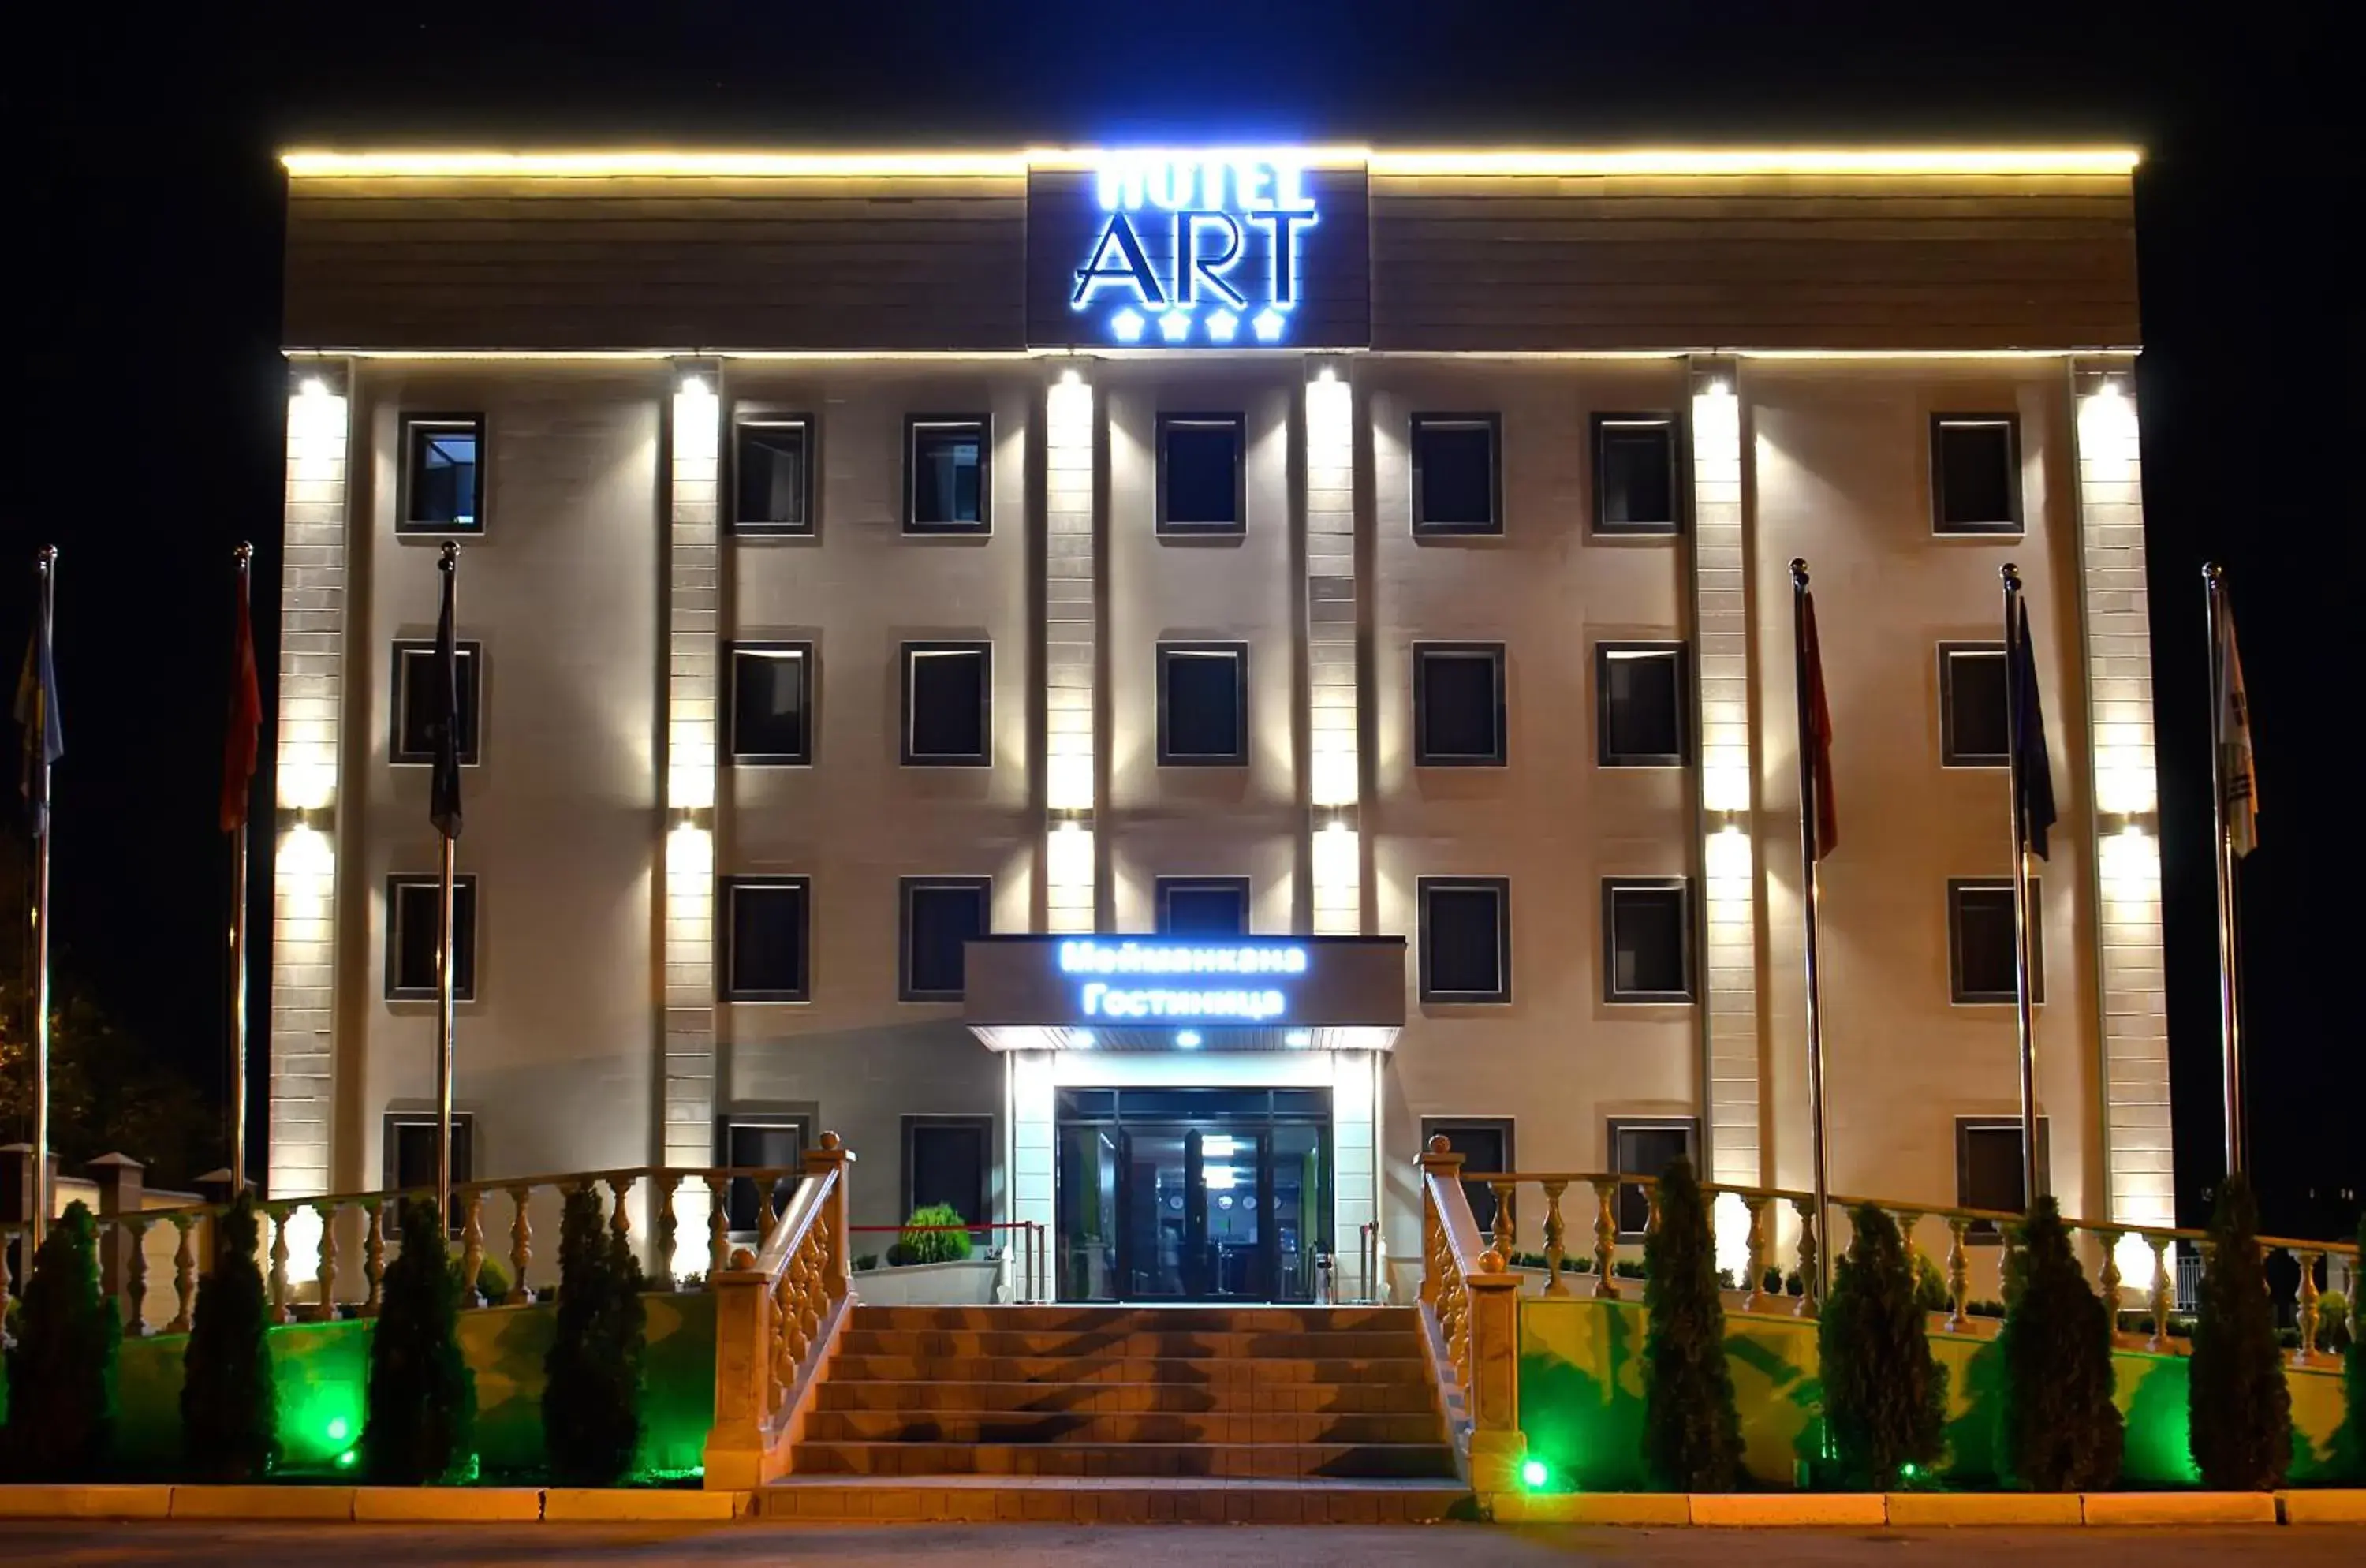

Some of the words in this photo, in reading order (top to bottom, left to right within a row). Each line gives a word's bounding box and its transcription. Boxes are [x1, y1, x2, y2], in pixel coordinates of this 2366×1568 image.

[1098, 150, 1315, 210] HOTEL
[1072, 211, 1319, 310] ART
[1084, 984, 1285, 1019] Гостиница
